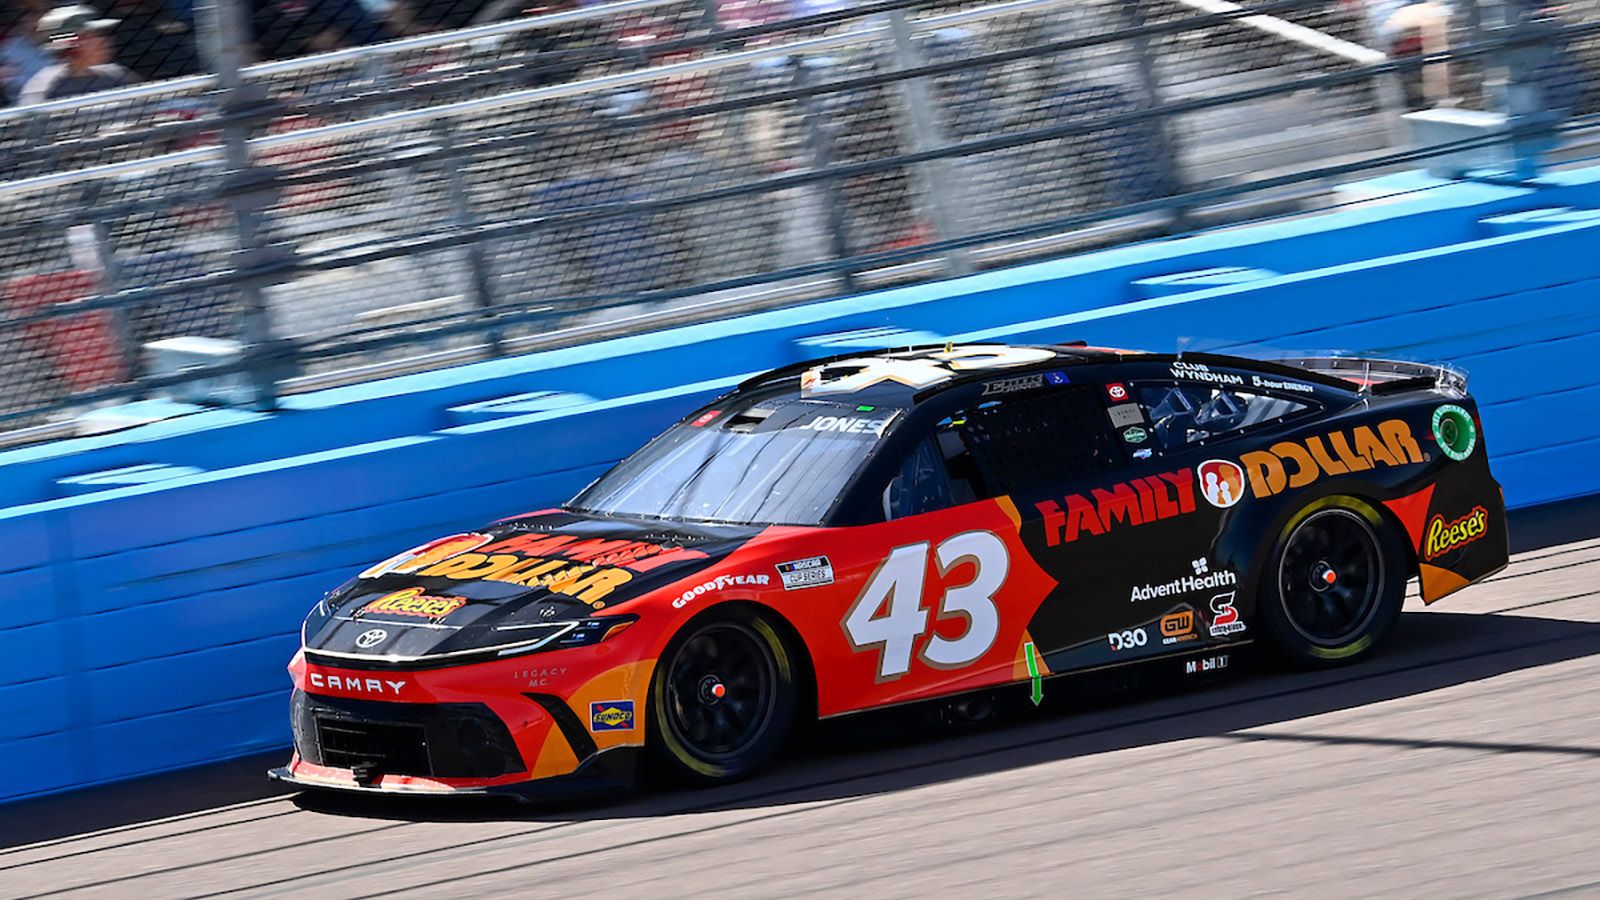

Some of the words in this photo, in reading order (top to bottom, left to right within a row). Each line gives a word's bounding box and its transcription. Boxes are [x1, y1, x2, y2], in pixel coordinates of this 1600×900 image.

[1170, 368, 1244, 384] WYNDHAM
[1172, 361, 1209, 372] CLUB
[801, 415, 883, 434] JONES
[1035, 468, 1197, 547] FAMILY
[1240, 419, 1423, 499] DOLLAR
[1427, 509, 1486, 557] Reese's
[672, 574, 770, 609] GOODYEAR
[1130, 570, 1237, 602] AdventHealth
[838, 529, 1010, 685] 43
[310, 673, 406, 695] CAMRY
[514, 667, 567, 679] LEGACY
[593, 710, 633, 723] SUNOCO
